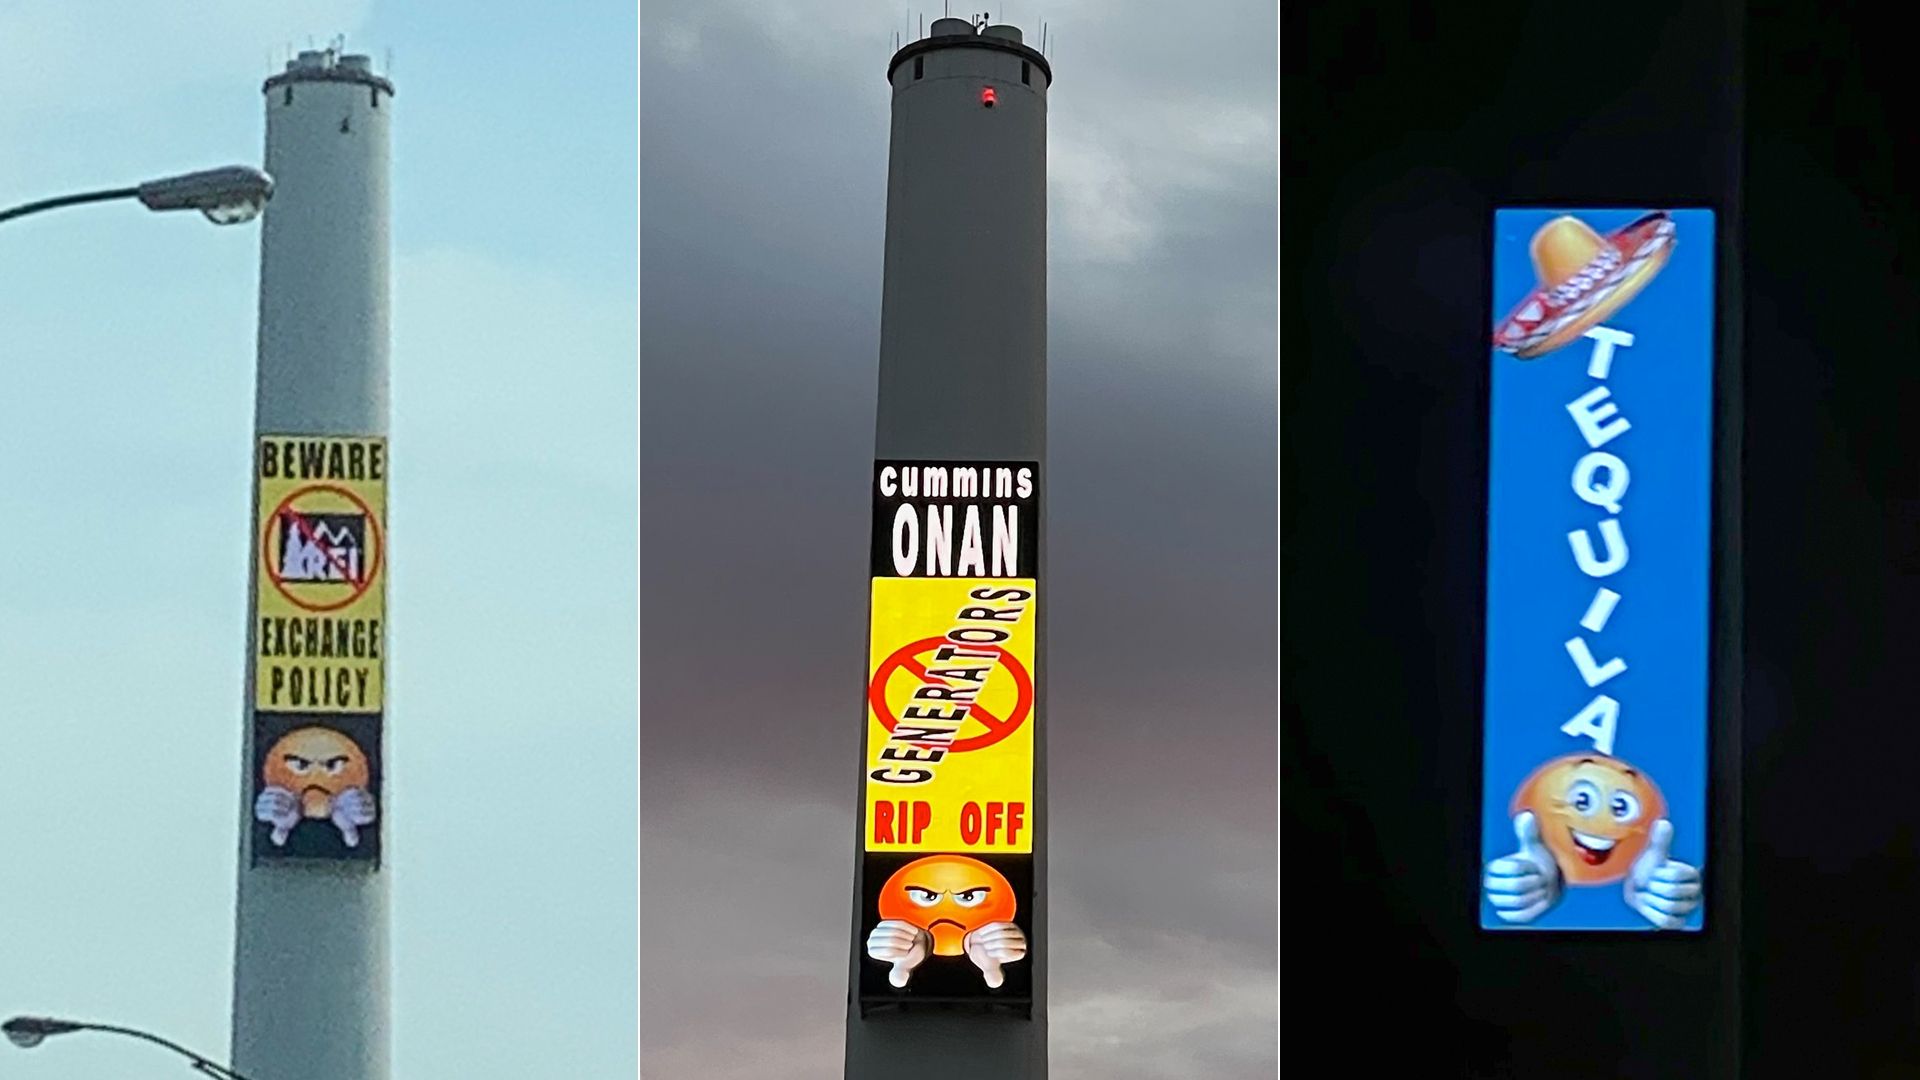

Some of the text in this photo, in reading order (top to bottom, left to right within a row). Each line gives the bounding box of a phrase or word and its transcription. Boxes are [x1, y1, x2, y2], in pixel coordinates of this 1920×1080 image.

[262, 441, 382, 480] BEWARE
[880, 466, 1033, 499] cummins
[892, 503, 1018, 577] ONAN
[1560, 325, 1635, 756] TEQUILA
[261, 617, 379, 658] EXCHANGE
[271, 666, 369, 706] POLICY
[870, 588, 1031, 783] GENERATORS
[874, 800, 1025, 845] RIP OFF
